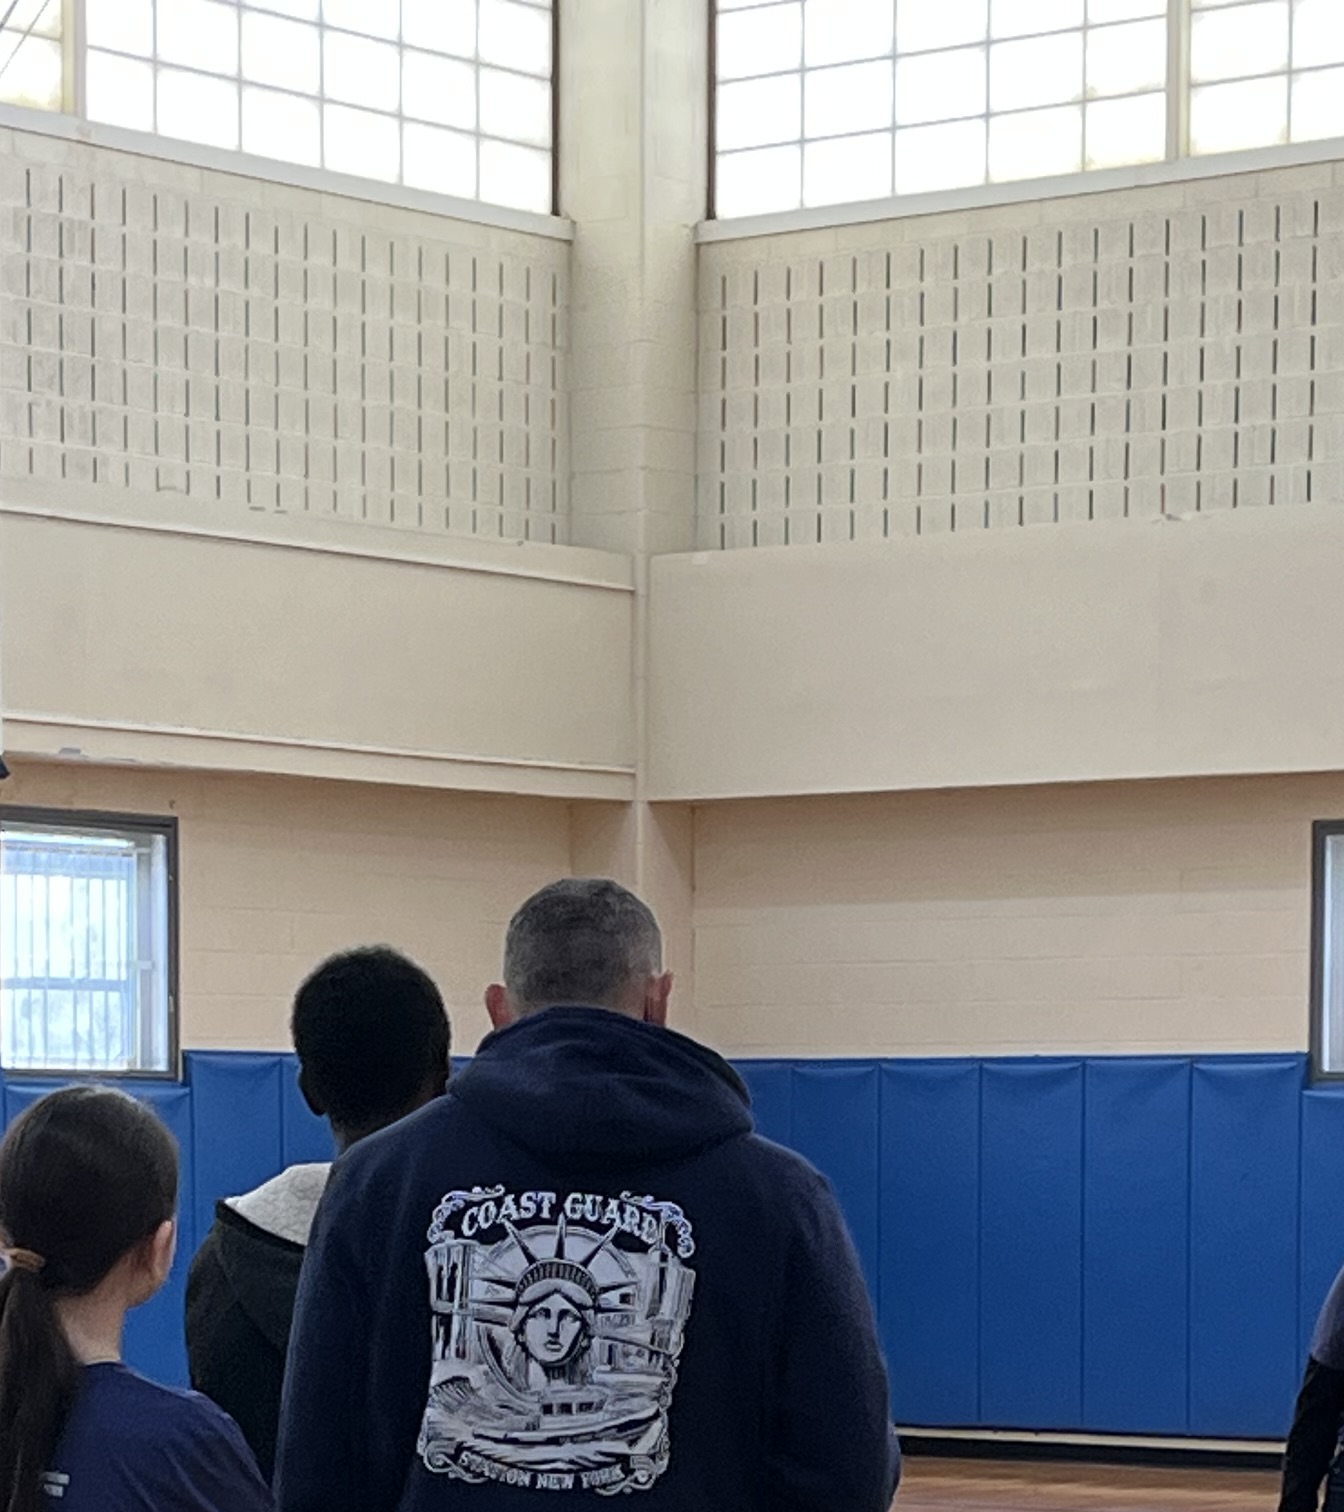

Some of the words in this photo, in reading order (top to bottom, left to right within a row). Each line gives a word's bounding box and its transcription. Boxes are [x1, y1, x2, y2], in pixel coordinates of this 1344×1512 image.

[460, 1190, 557, 1238] COAST
[564, 1191, 661, 1245] GUARD
[457, 1450, 532, 1488] STATION
[536, 1473, 575, 1490] NEW
[581, 1463, 626, 1489] YORK
